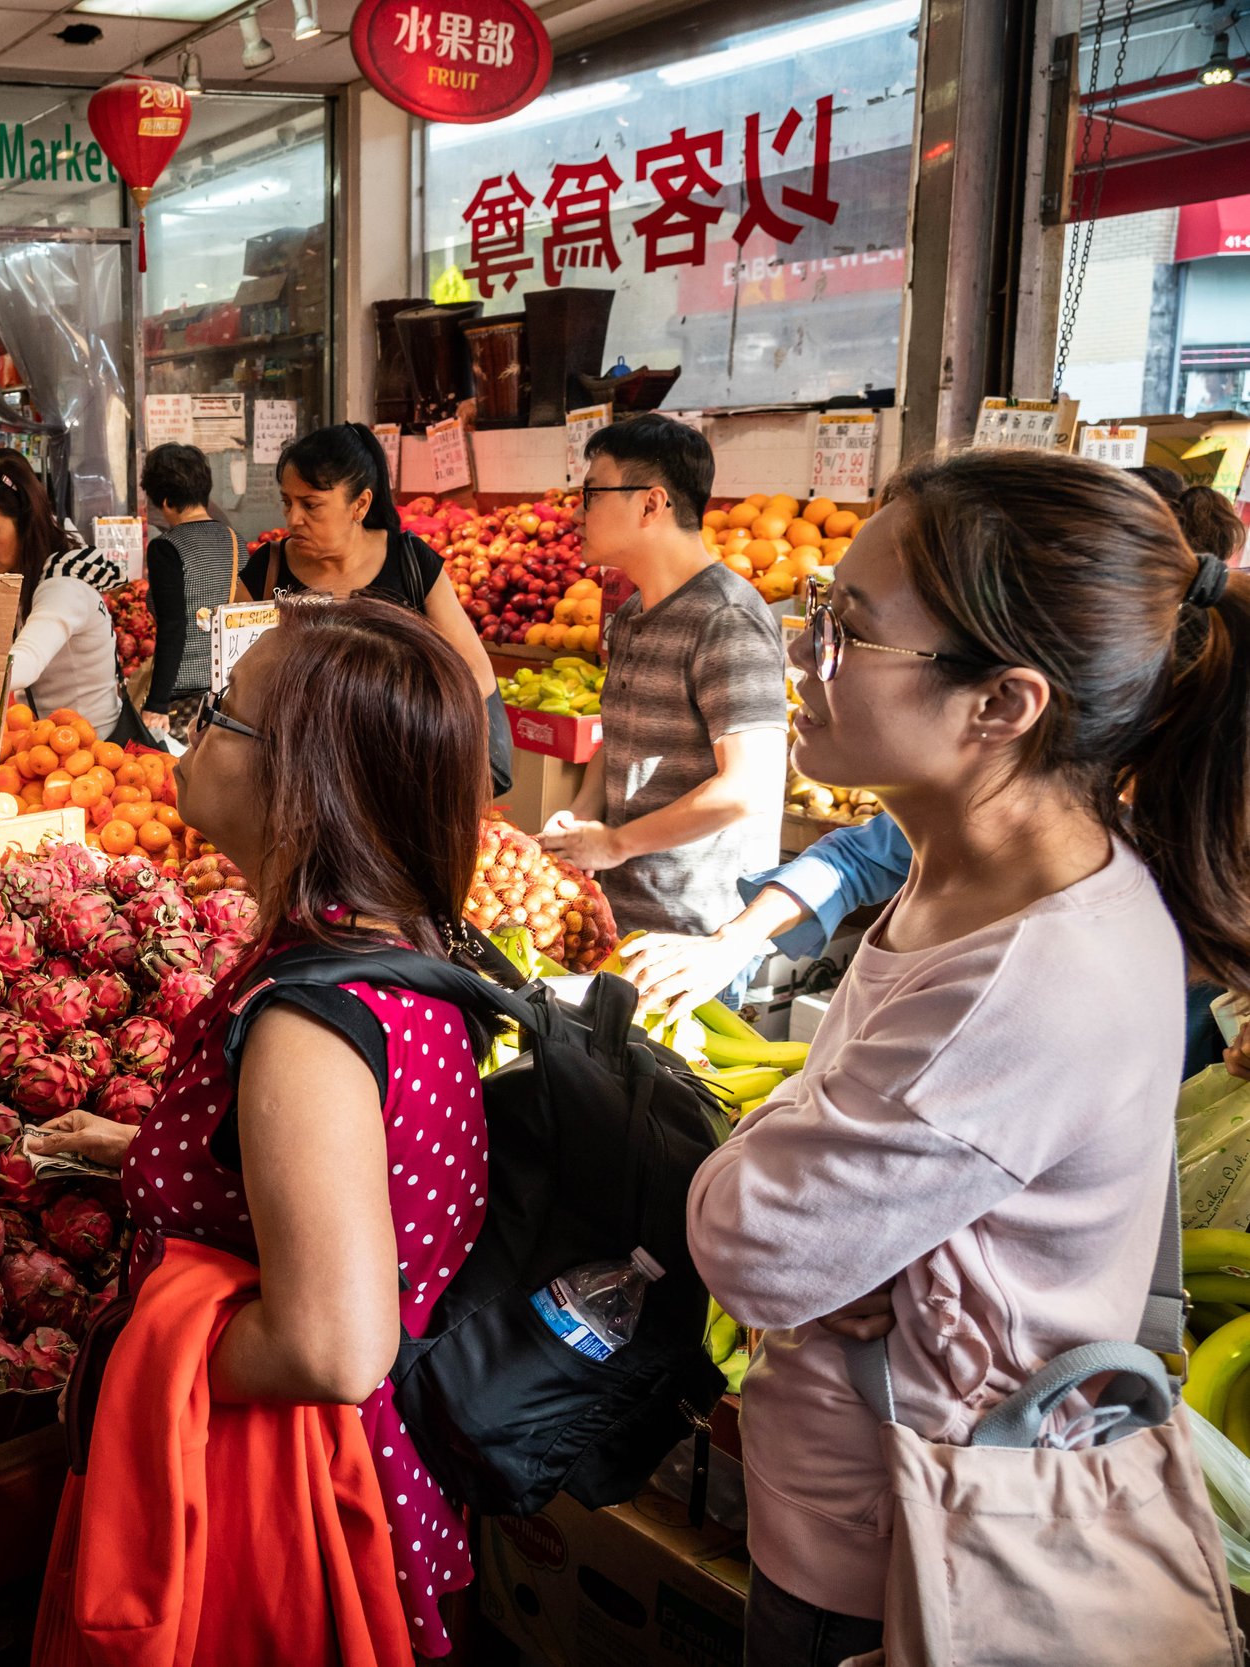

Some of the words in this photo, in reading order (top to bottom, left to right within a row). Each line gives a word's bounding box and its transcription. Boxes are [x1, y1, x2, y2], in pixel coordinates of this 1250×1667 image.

[393, 8, 516, 68] 水果部
[427, 65, 480, 91] FRUIT
[520, 1517, 564, 1560] Monte
